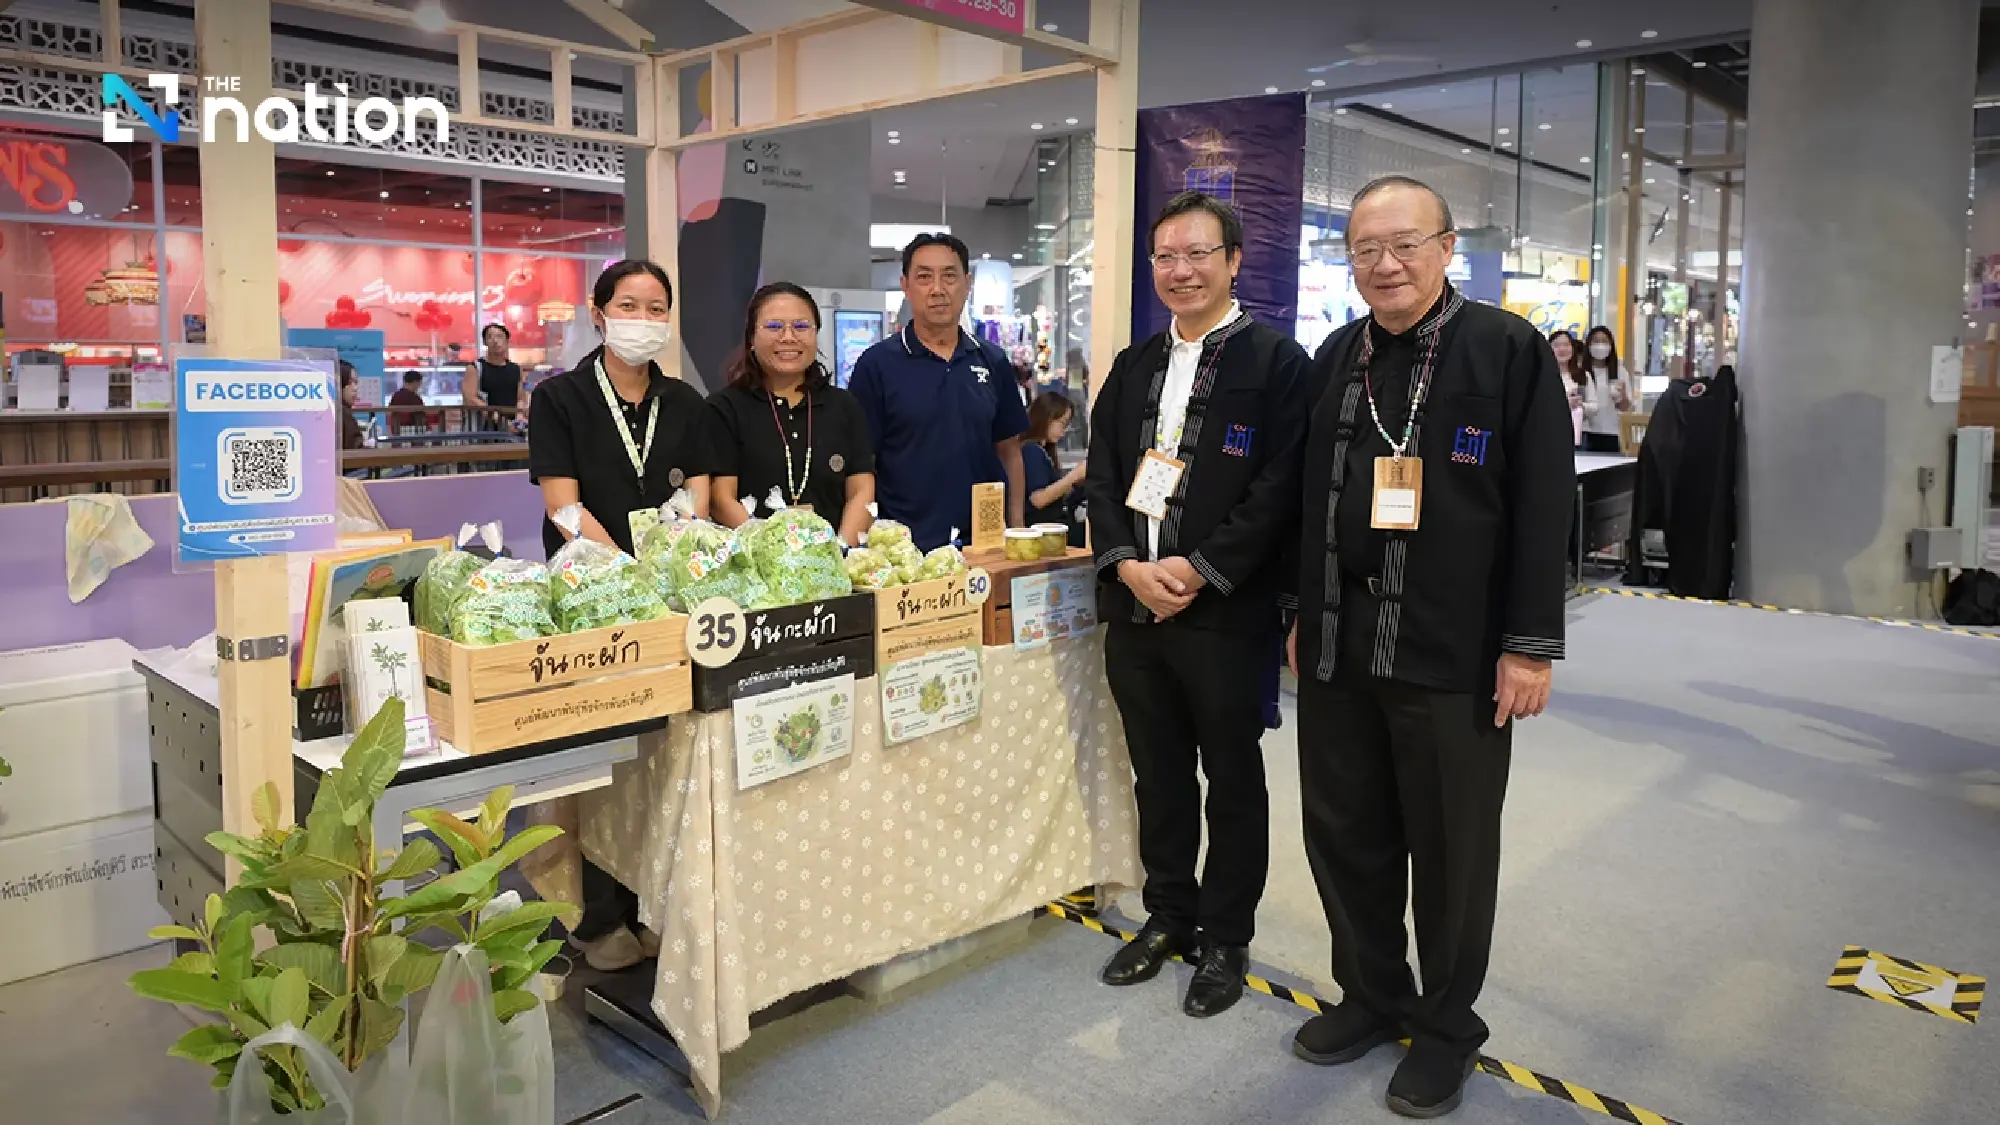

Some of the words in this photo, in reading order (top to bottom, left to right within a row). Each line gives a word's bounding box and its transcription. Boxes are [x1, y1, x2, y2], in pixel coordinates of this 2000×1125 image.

[196, 383, 323, 400] FACEBOOK
[968, 576, 987, 594] 50
[695, 613, 737, 651] 35
